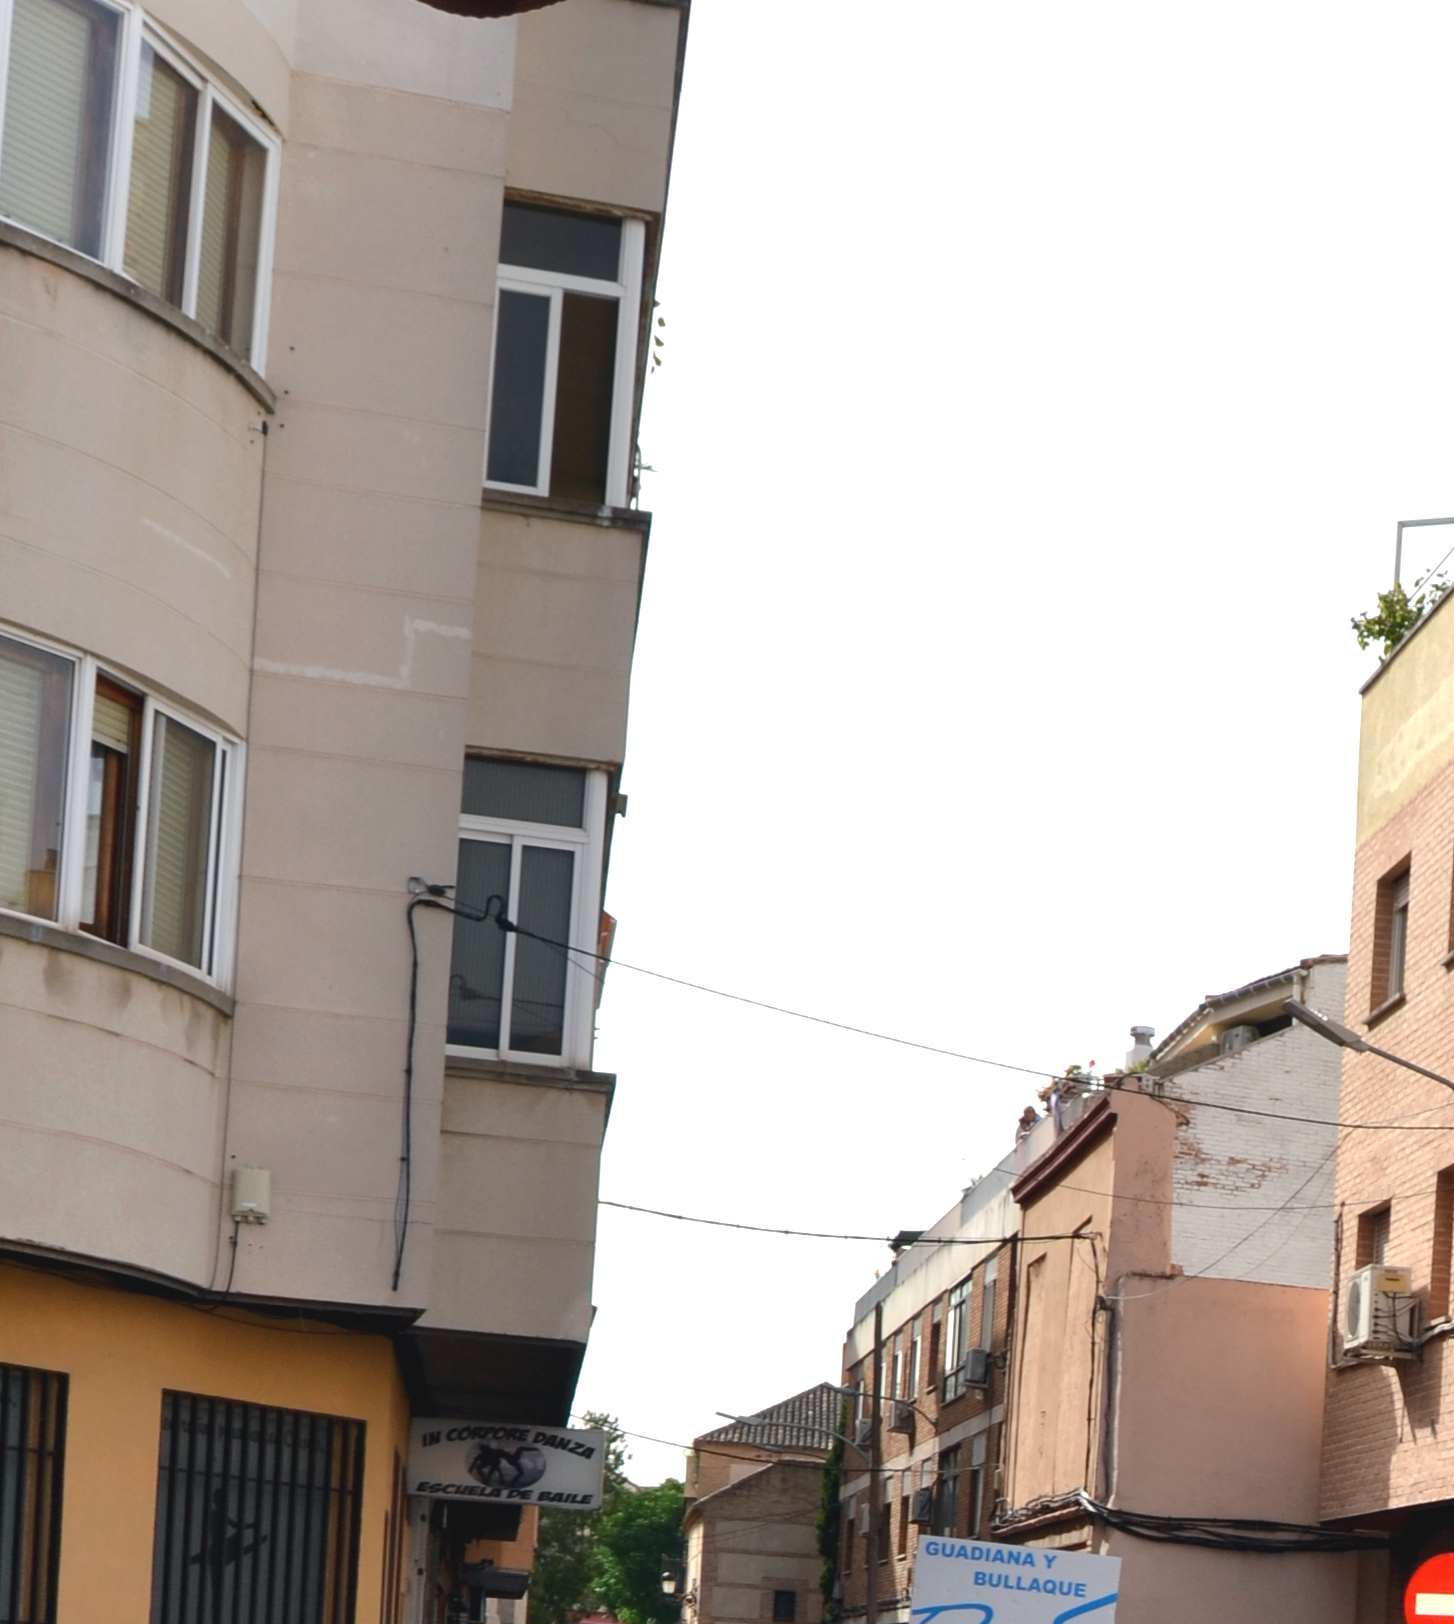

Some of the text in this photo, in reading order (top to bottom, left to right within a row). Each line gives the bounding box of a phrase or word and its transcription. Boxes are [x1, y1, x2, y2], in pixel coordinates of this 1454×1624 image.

[423, 1431, 441, 1447] IN
[533, 1432, 595, 1459] DANZA
[416, 1481, 594, 1505] ESCUELA DE BAILE
[925, 1541, 1057, 1569] GUADIANA Y
[973, 1571, 1087, 1598] BULLAQUE
